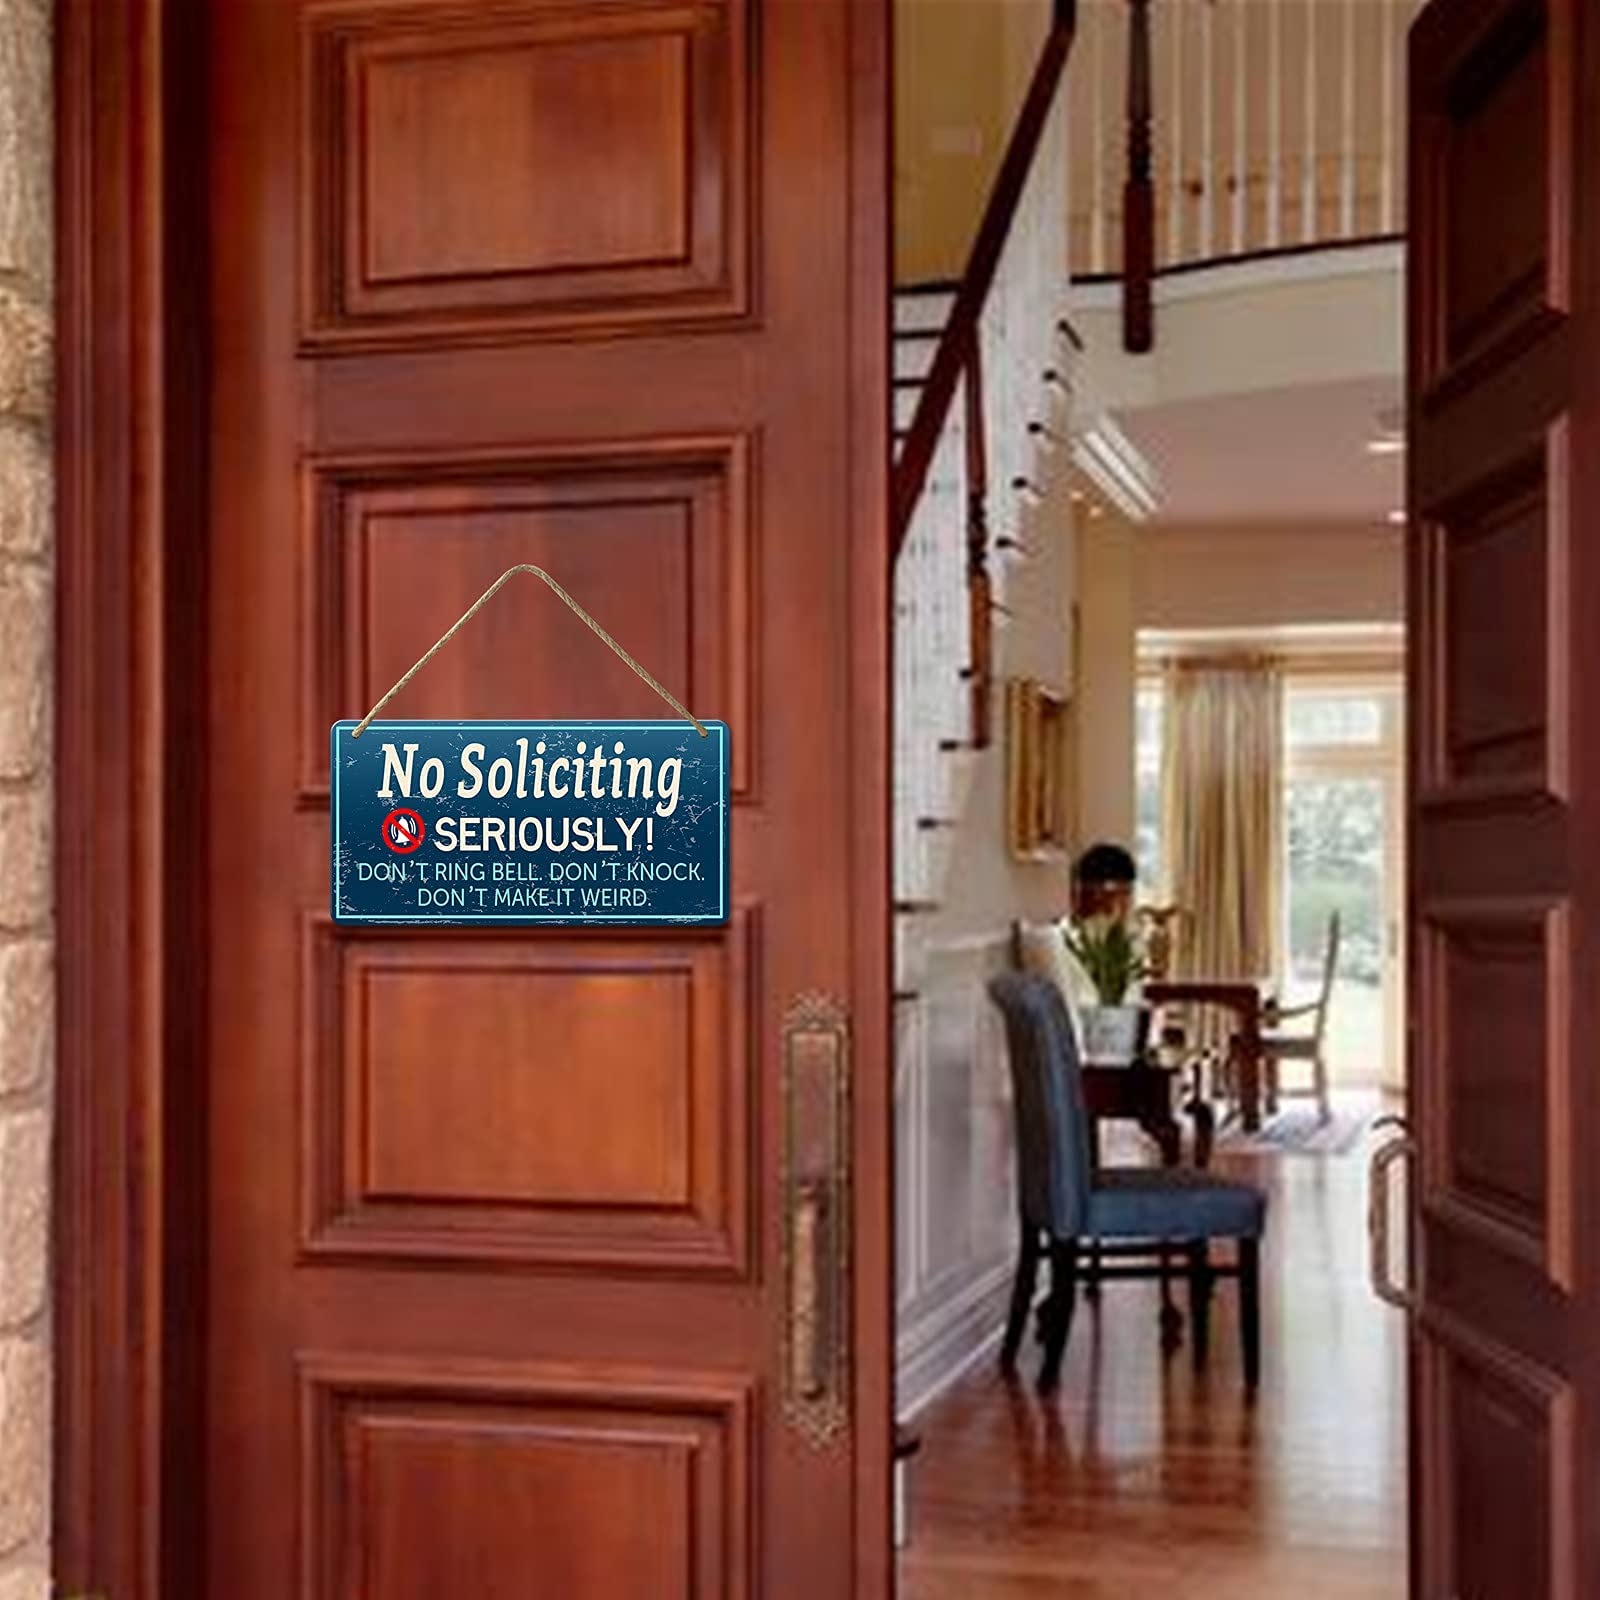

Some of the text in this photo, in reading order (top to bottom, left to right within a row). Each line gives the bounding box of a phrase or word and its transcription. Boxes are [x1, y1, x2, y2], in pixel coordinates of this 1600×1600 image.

[377, 737, 682, 817] No Soliciting
[434, 816, 654, 852] SERIOUSLY!
[358, 860, 705, 881] DON’T RING BELL. DON’T KNOCK.
[418, 886, 652, 907] DON’T MAKE IT WEIRD.
